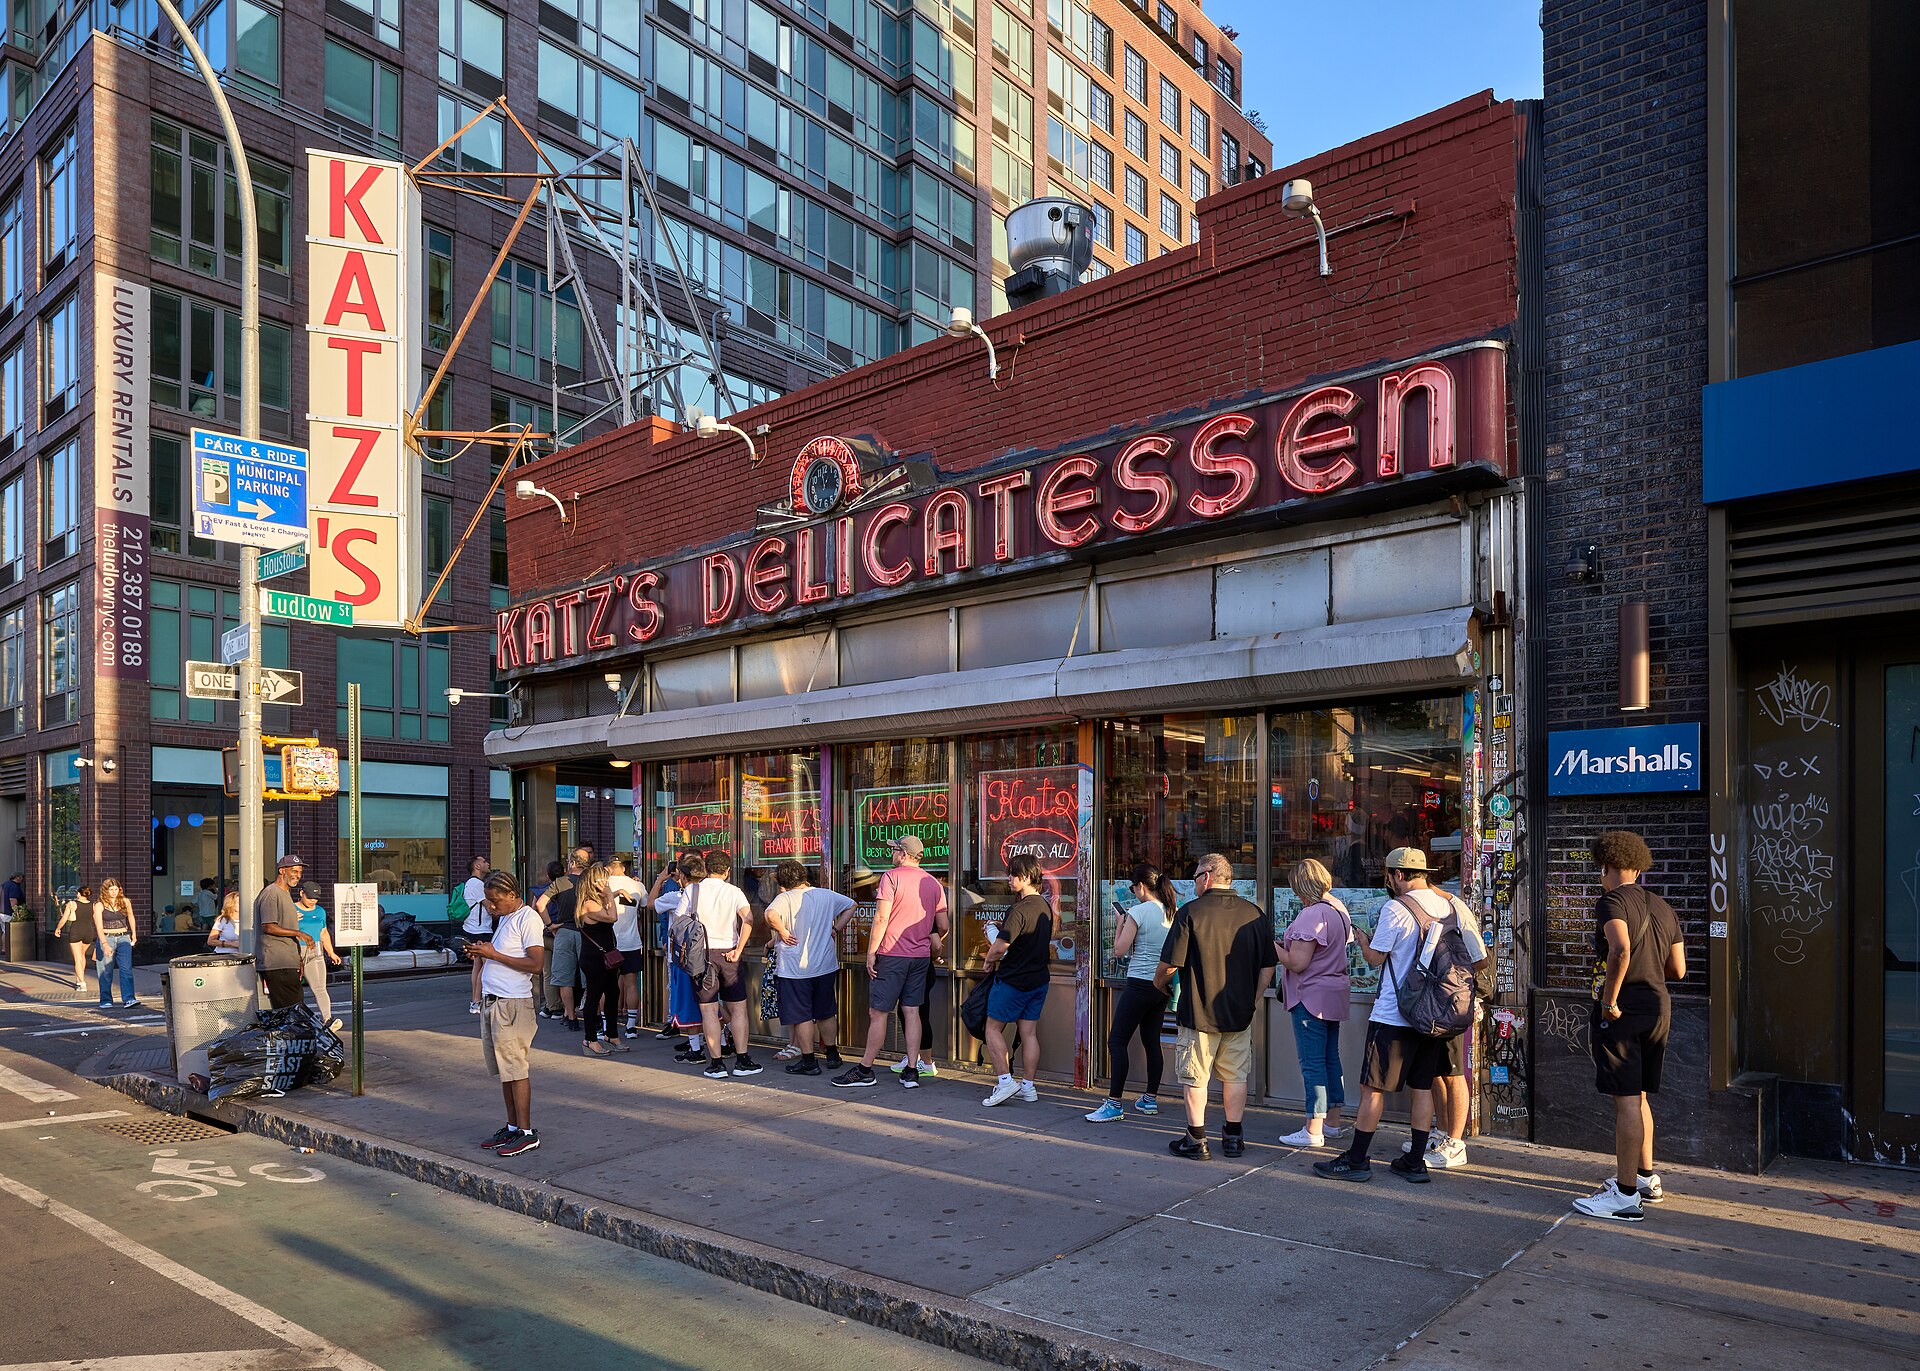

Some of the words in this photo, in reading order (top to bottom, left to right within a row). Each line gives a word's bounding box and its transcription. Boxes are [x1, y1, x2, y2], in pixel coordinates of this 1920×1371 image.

[112, 285, 134, 387] LUXURY
[317, 160, 386, 607] KATZ'S
[112, 391, 133, 504] RENTALS
[204, 437, 243, 455] PARK
[250, 447, 260, 458] &
[267, 450, 297, 465] RIDE
[236, 463, 302, 486] MUNICIPAL
[812, 476, 818, 485] 10
[817, 469, 822, 477] 11
[822, 465, 828, 474] 12
[237, 478, 290, 498] PARKING
[824, 499, 829, 508] 6
[225, 520, 241, 528] Fast
[250, 524, 269, 532] Level
[277, 528, 309, 539] Charging
[264, 551, 296, 577] Houston
[298, 543, 305, 558] St
[101, 523, 116, 667] theludlownyc.com
[122, 527, 143, 668] 212.387.0188
[268, 593, 332, 621] Ludlow
[339, 605, 350, 617] St
[497, 571, 665, 670] KATZ'S
[201, 673, 232, 688] ONE
[261, 679, 280, 692] AY
[1554, 744, 1694, 776] Marshalls
[870, 792, 947, 825] KATZ'S
[764, 836, 821, 854] FRANKFURTE
[866, 847, 884, 858] BEST
[933, 845, 949, 857] TOW
[1049, 843, 1071, 859] ALL
[1709, 833, 1728, 913] UNO
[265, 1057, 302, 1074] EAST
[261, 1074, 296, 1091] SIDE
